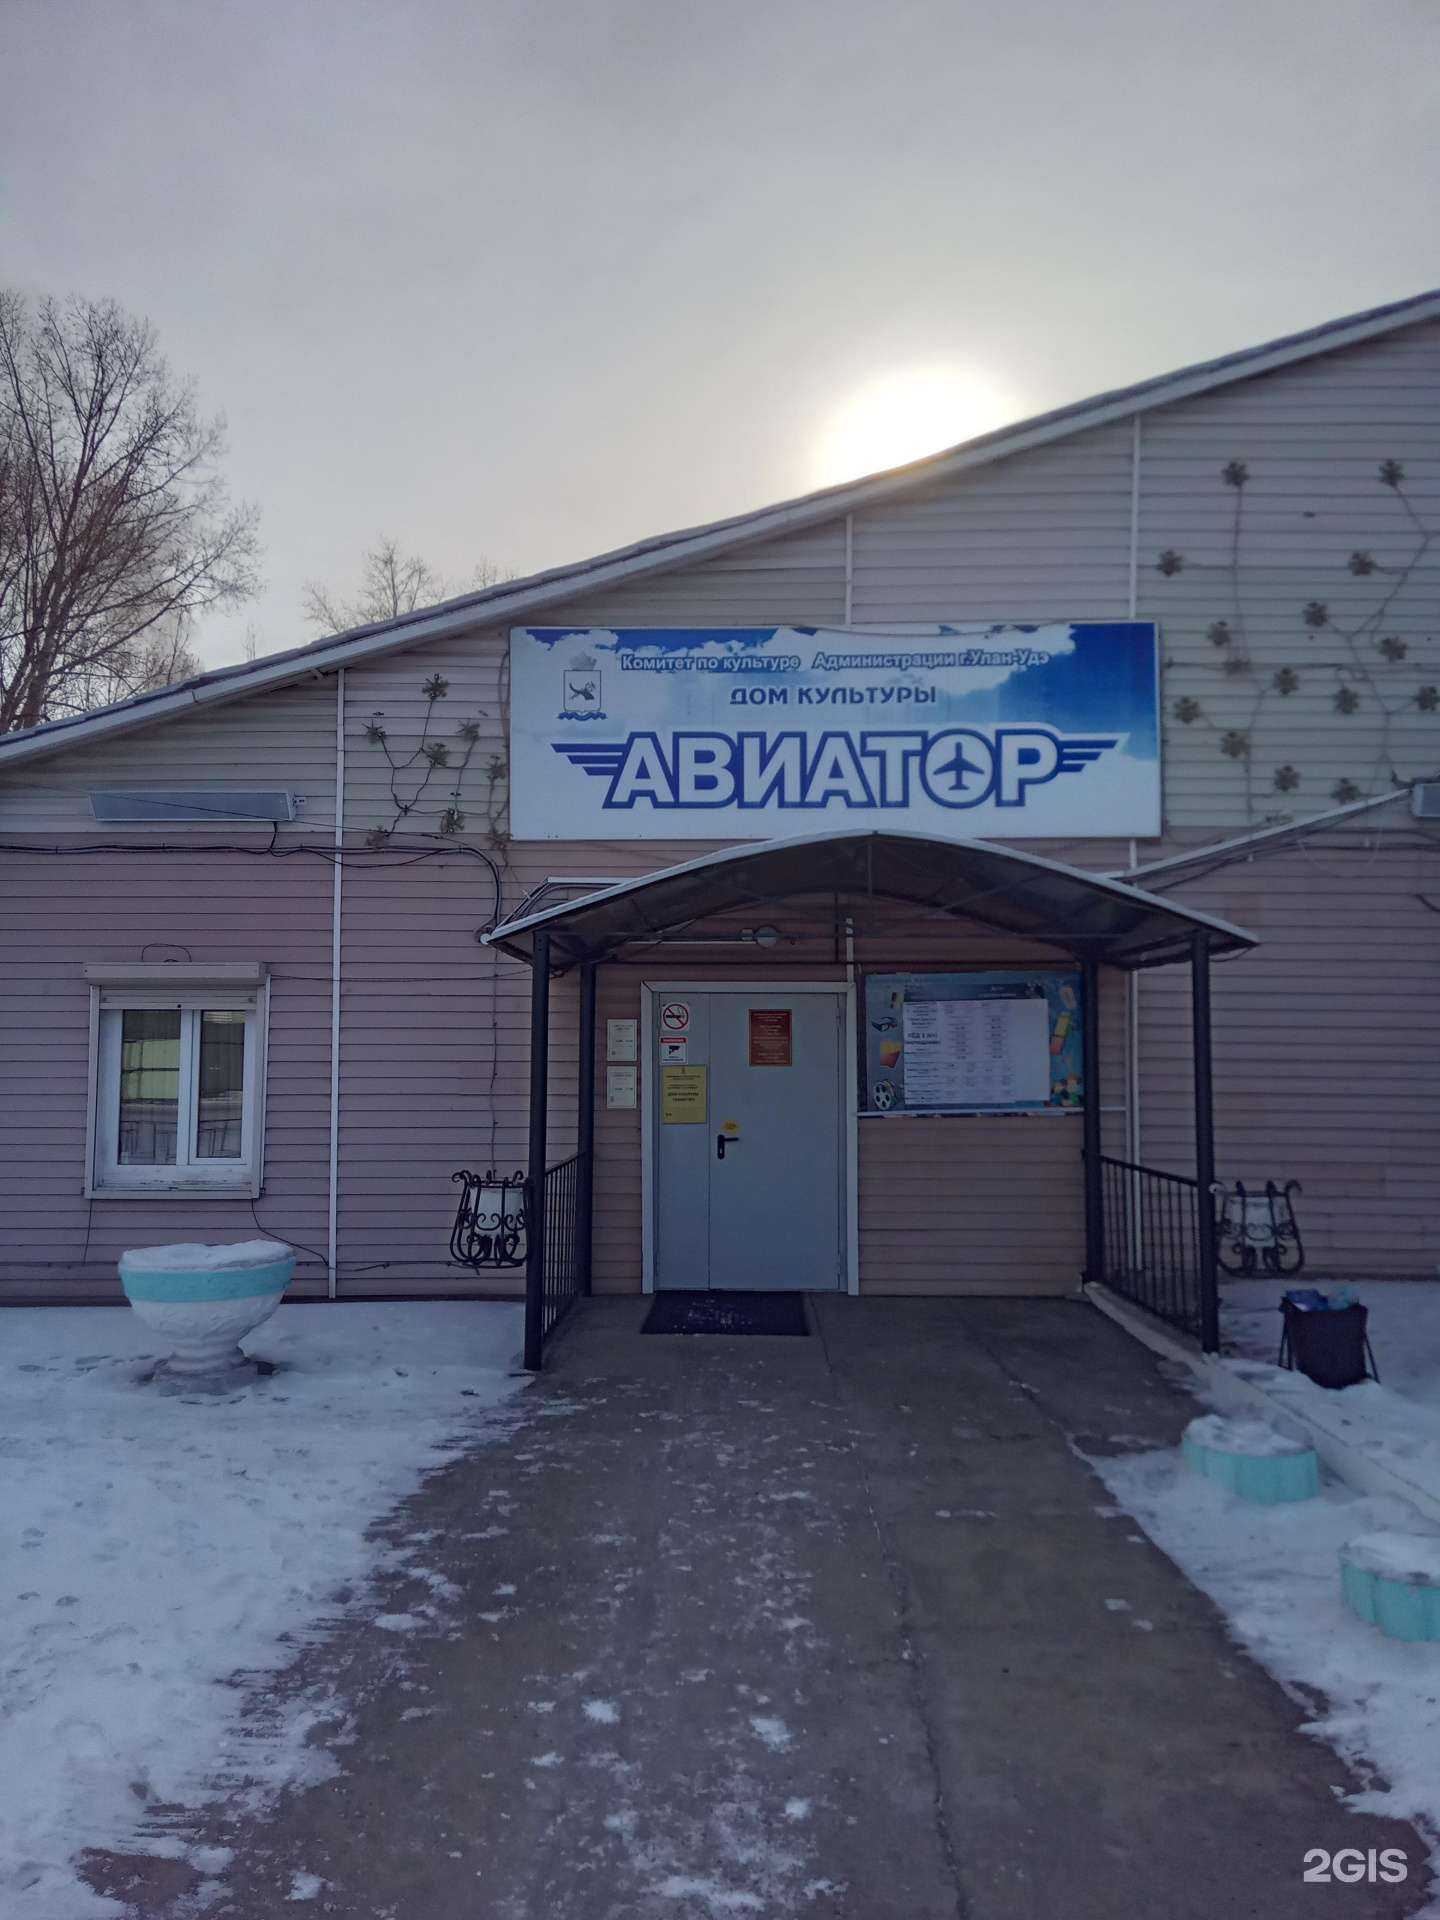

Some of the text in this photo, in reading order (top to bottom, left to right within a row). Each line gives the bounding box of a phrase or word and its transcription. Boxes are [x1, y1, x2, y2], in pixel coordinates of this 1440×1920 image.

[621, 654, 693, 671] Комитет
[695, 656, 718, 671] по
[721, 655, 801, 673] культуре
[811, 651, 955, 671] Администрации
[730, 686, 936, 705] ДОМ КУЛЬТУРЫ
[602, 729, 1061, 810] АВИАТОР
